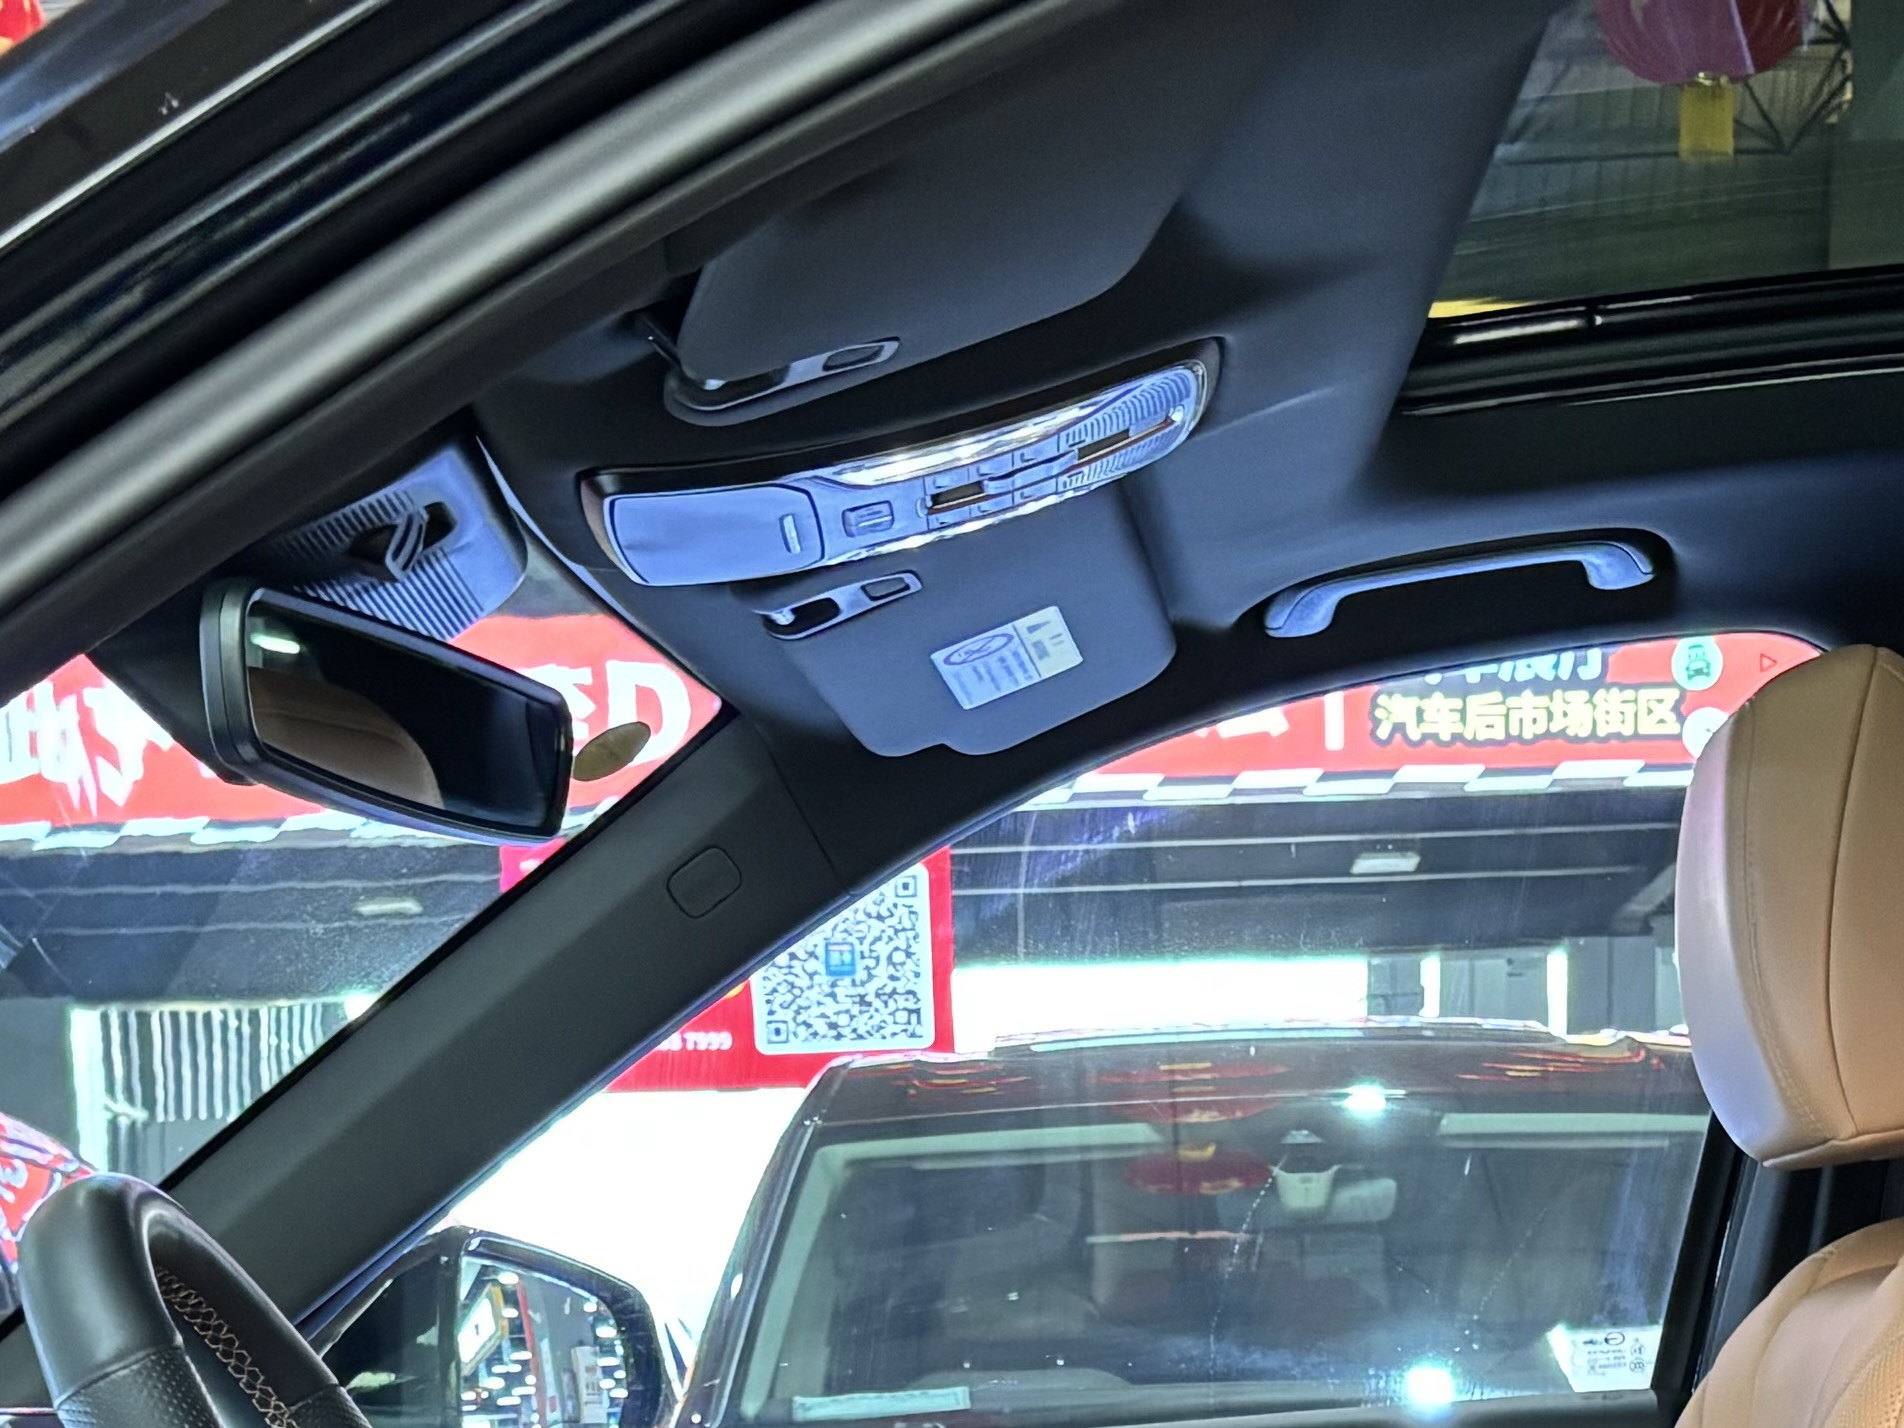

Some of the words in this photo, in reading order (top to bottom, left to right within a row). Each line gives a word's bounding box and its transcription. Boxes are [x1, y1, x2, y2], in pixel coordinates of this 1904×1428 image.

[1375, 689, 1681, 741] 汽车后市场街区
